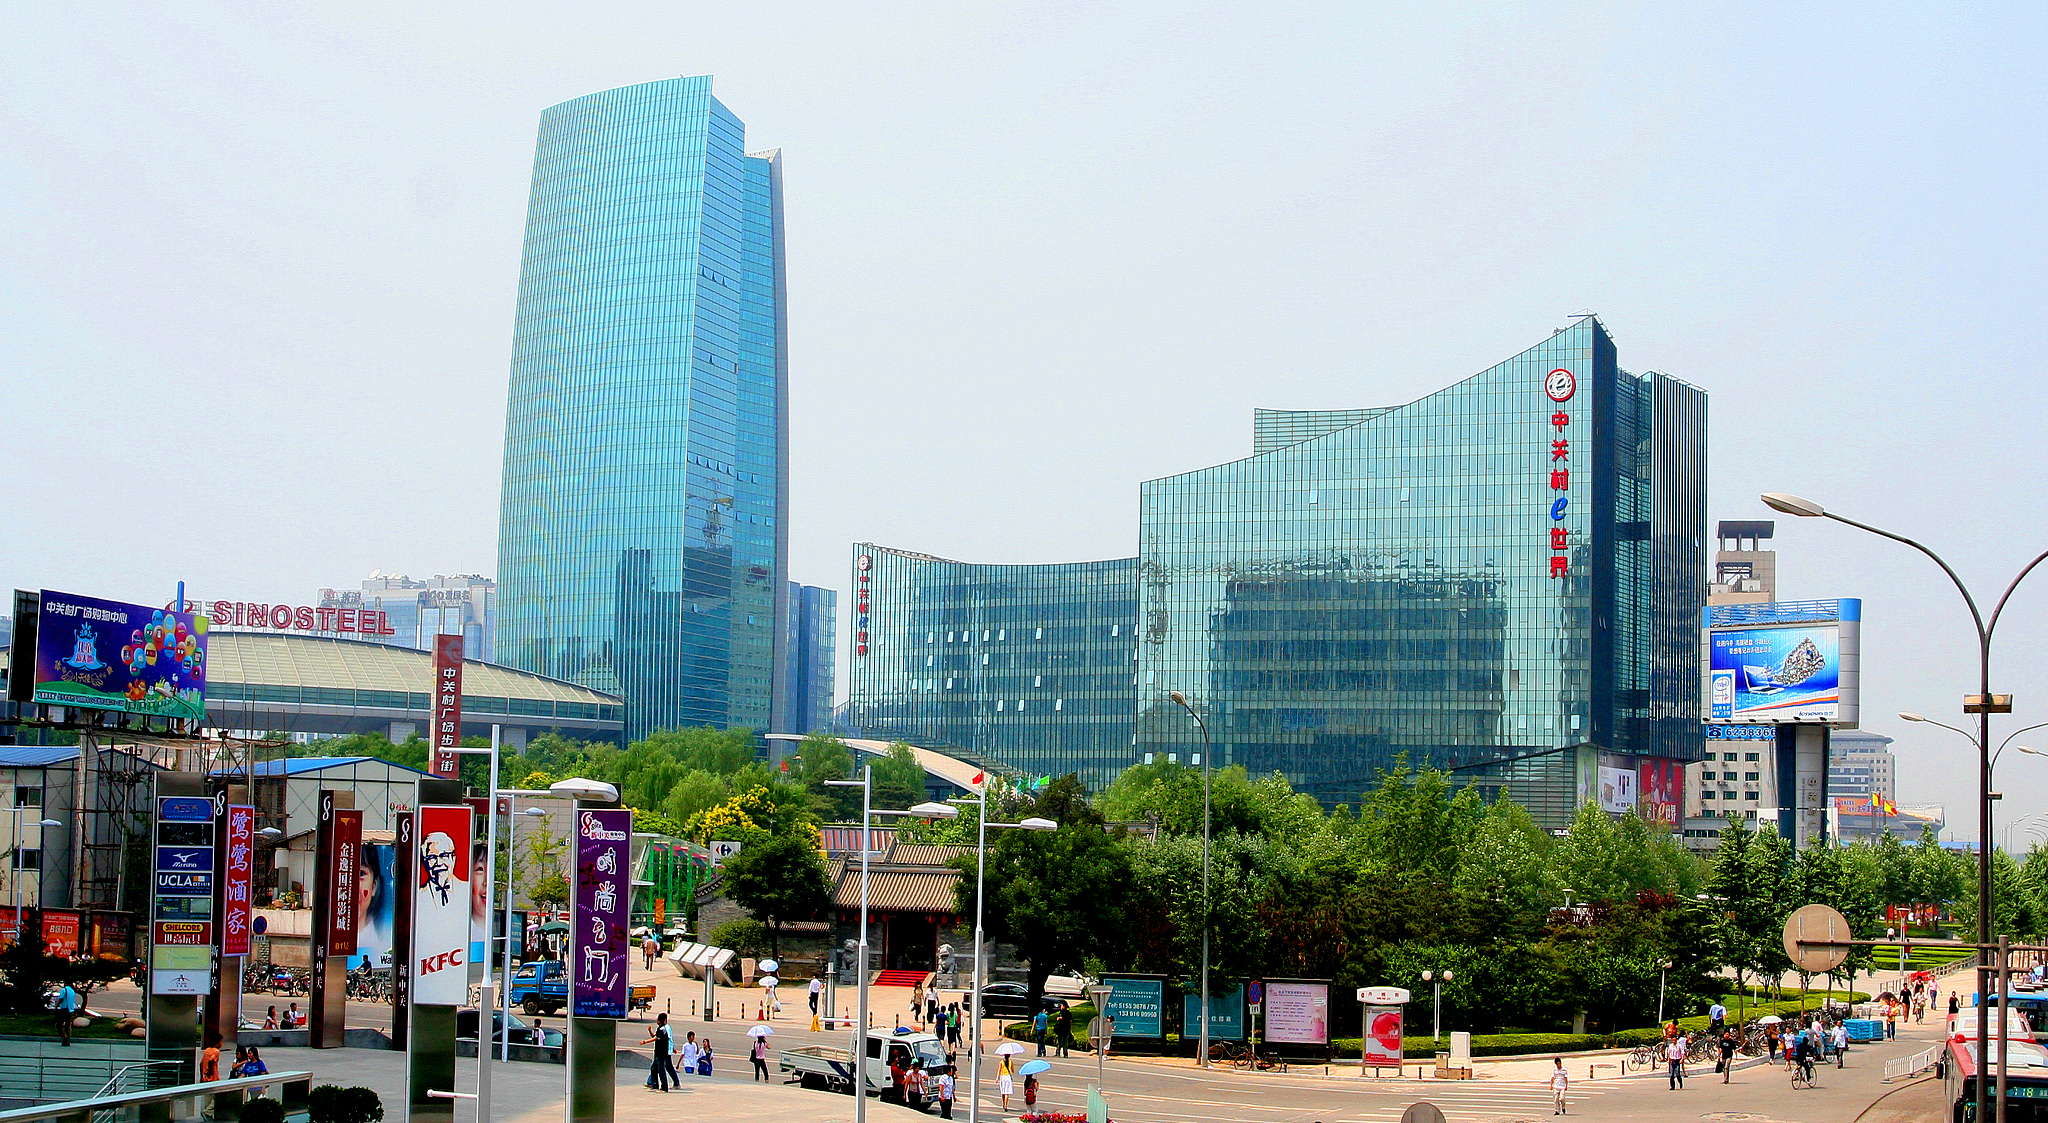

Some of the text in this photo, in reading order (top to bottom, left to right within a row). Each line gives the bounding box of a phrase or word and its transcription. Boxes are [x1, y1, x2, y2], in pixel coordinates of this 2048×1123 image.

[1550, 410, 1569, 579] 中关村e世界
[46, 601, 129, 625] 中关村广场购物中心
[212, 600, 396, 636] SINOSTEEL
[440, 667, 457, 773] 中关村广场步行街
[159, 875, 192, 886] UCLA
[227, 810, 251, 935] 鹭鹭酒家
[336, 842, 350, 931] 金逸国际影城
[165, 924, 201, 932] SHELCORE
[420, 948, 464, 976] KFC
[1196, 1015, 1232, 1023] 广位招商
